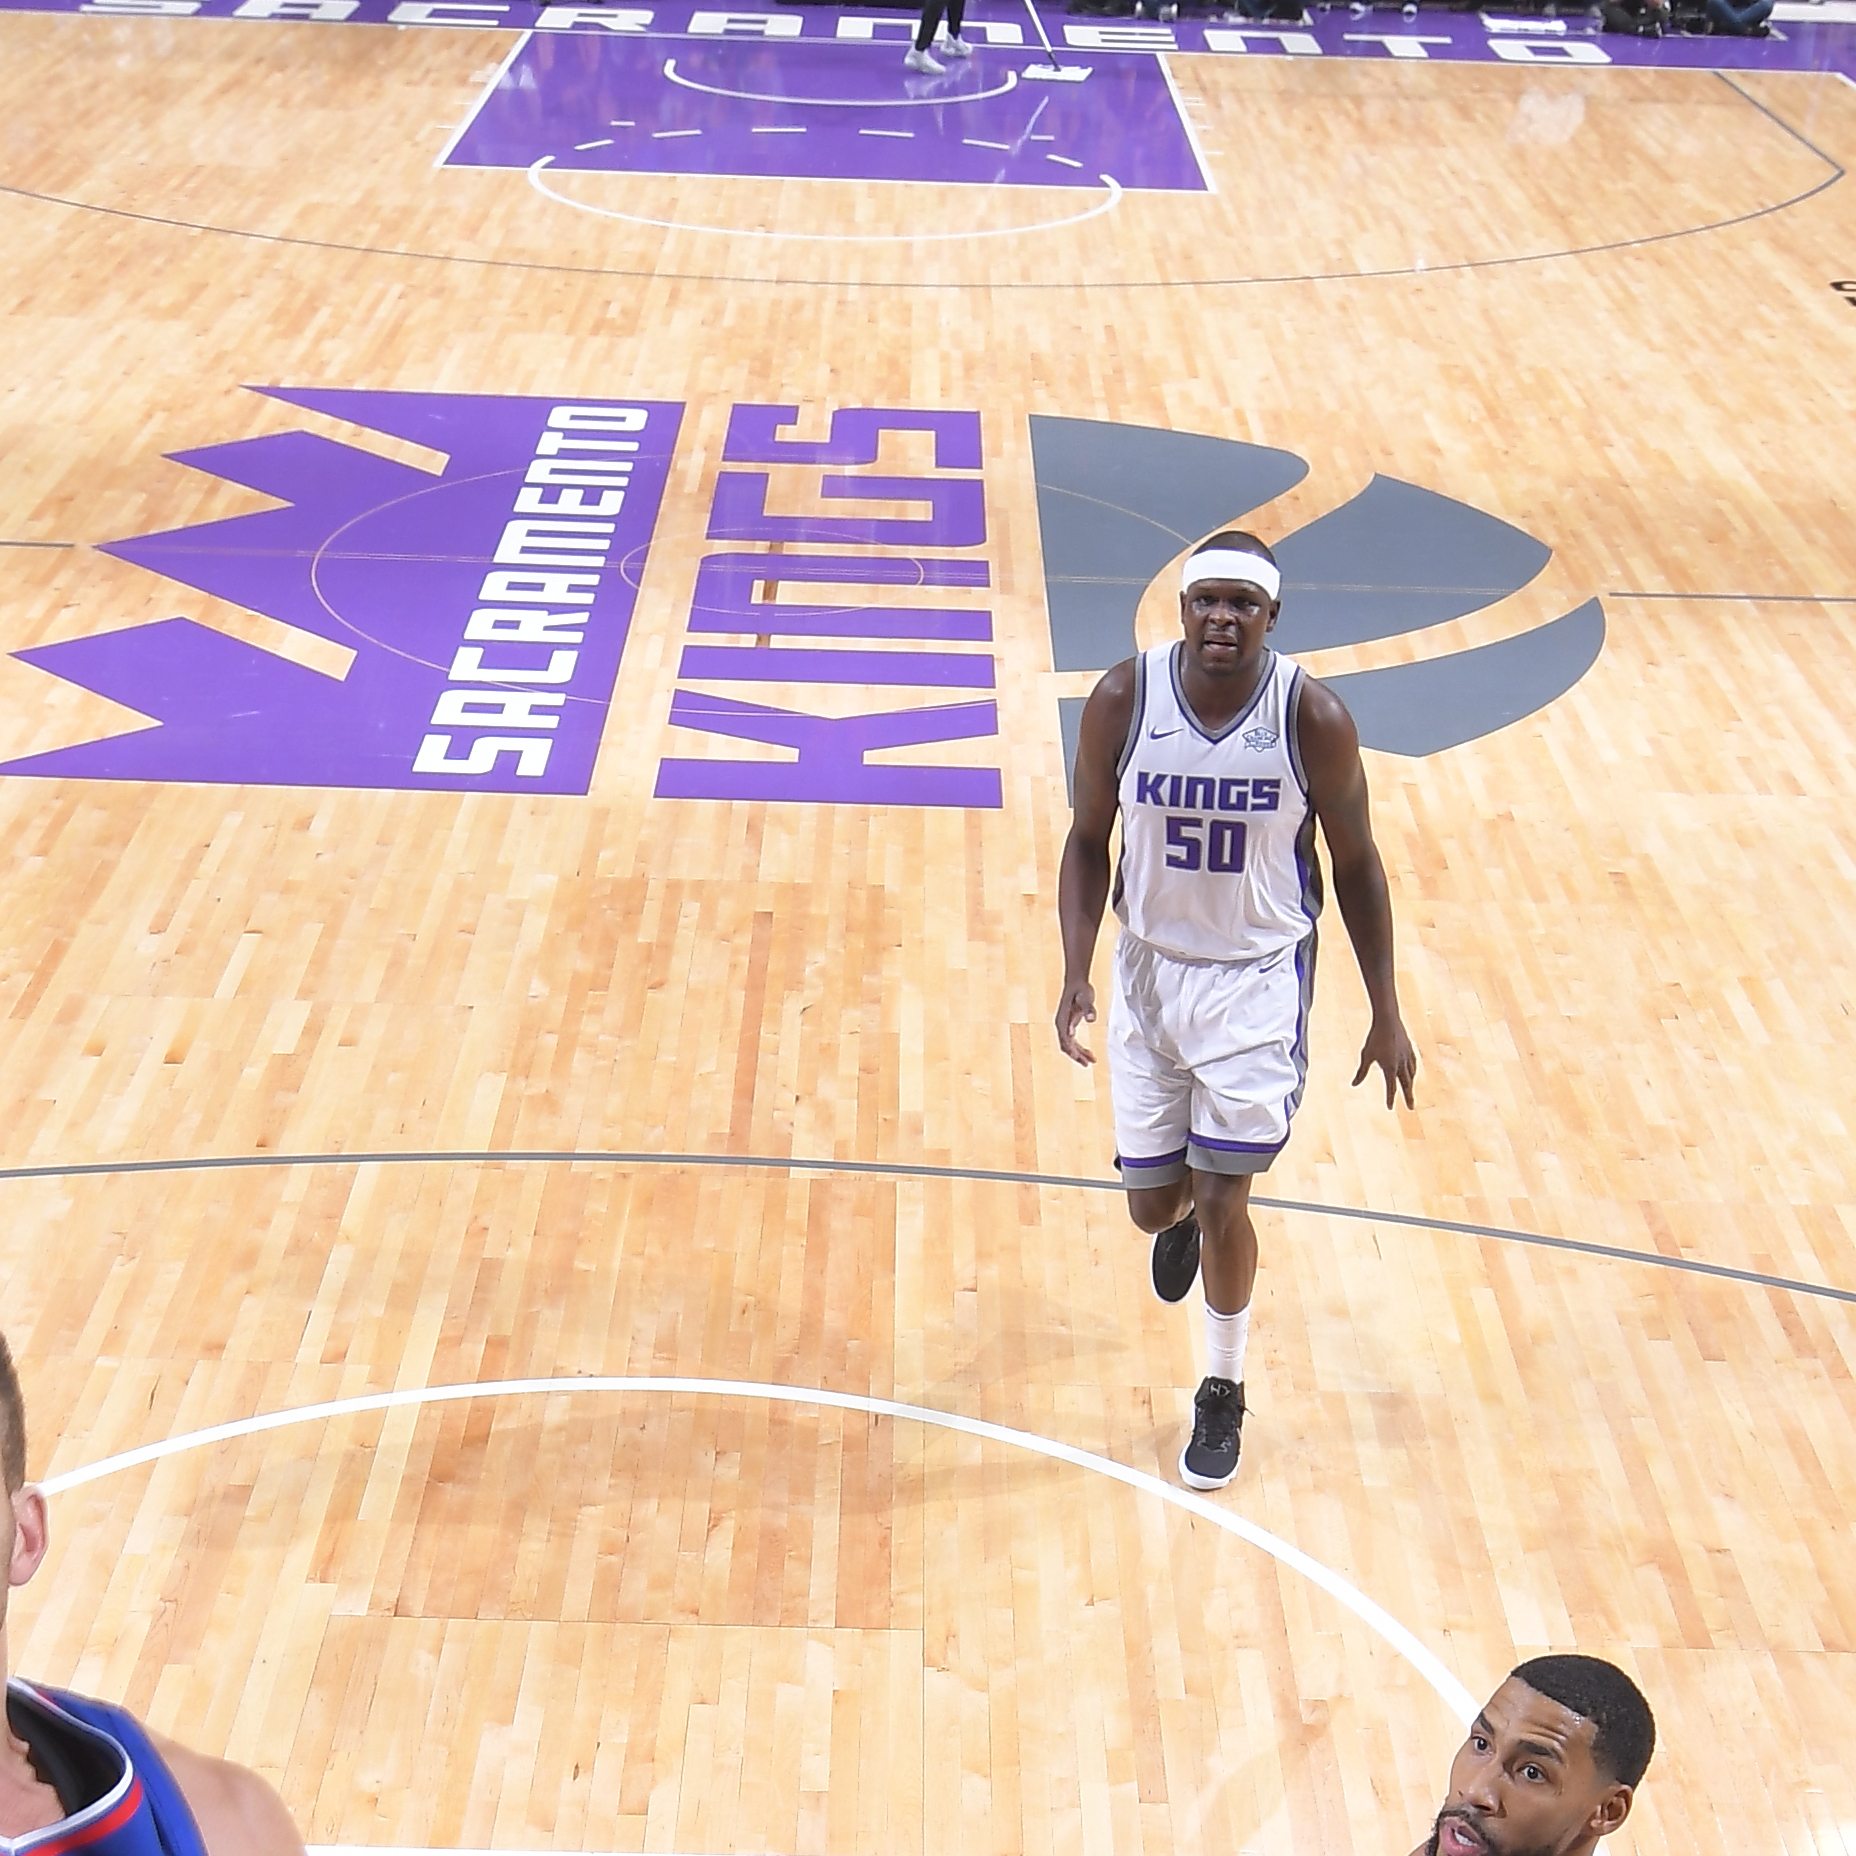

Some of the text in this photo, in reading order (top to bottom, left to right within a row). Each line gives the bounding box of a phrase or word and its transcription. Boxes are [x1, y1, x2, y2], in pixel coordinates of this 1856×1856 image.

[79, 0, 1613, 64] SACRAMENTO
[412, 405, 649, 778] SACRAMENTO
[654, 403, 1003, 809] KINGS
[1136, 771, 1282, 813] KINGS
[1165, 815, 1248, 874] 50
